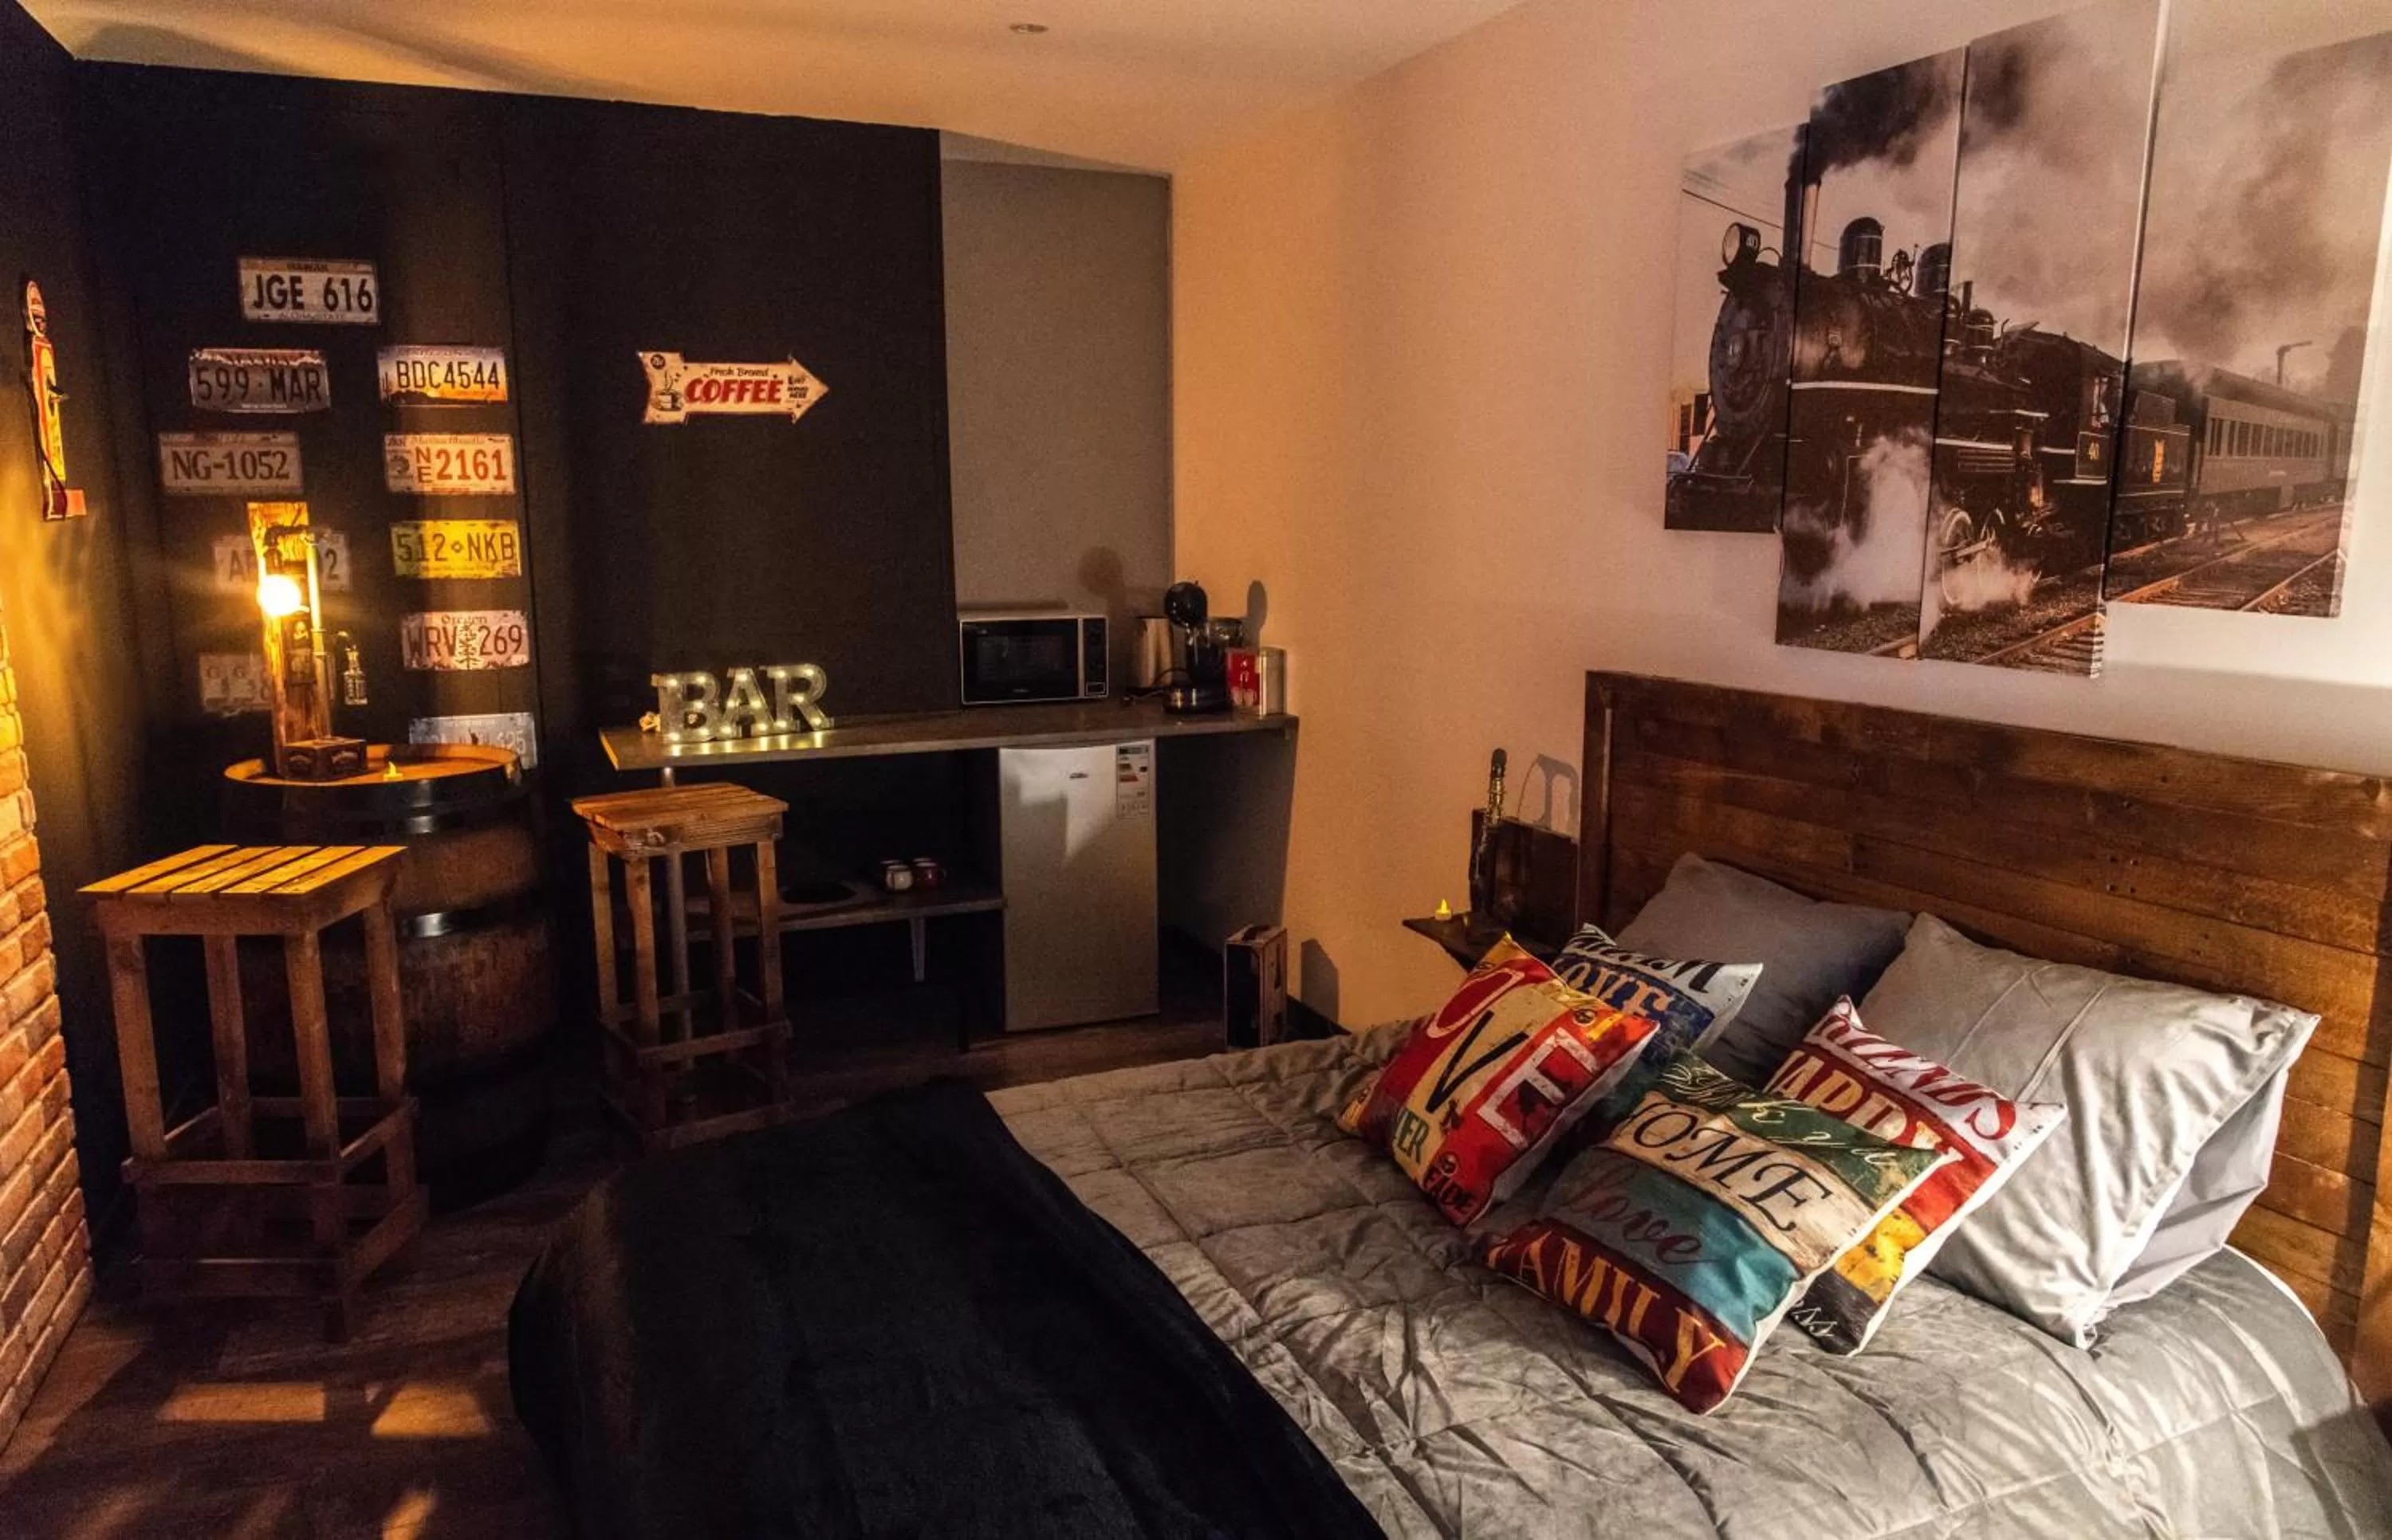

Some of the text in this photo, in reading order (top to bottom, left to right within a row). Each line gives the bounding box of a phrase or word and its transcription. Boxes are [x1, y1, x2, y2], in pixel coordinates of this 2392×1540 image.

[252, 273, 372, 312] JGE 616
[196, 367, 322, 402] 599 MAR
[395, 360, 499, 389] BDC4544
[684, 377, 784, 403] COFFEE
[171, 450, 289, 480] NG-1052
[435, 448, 508, 481] 2161
[396, 532, 515, 562] 512 NKB
[406, 624, 522, 658] WRV 269
[651, 663, 835, 743] BAR
[1552, 959, 1673, 1017] OVE
[1426, 966, 1597, 1149] OVE
[1814, 1015, 2016, 1140] RIENDS
[1622, 1102, 1833, 1232] OME
